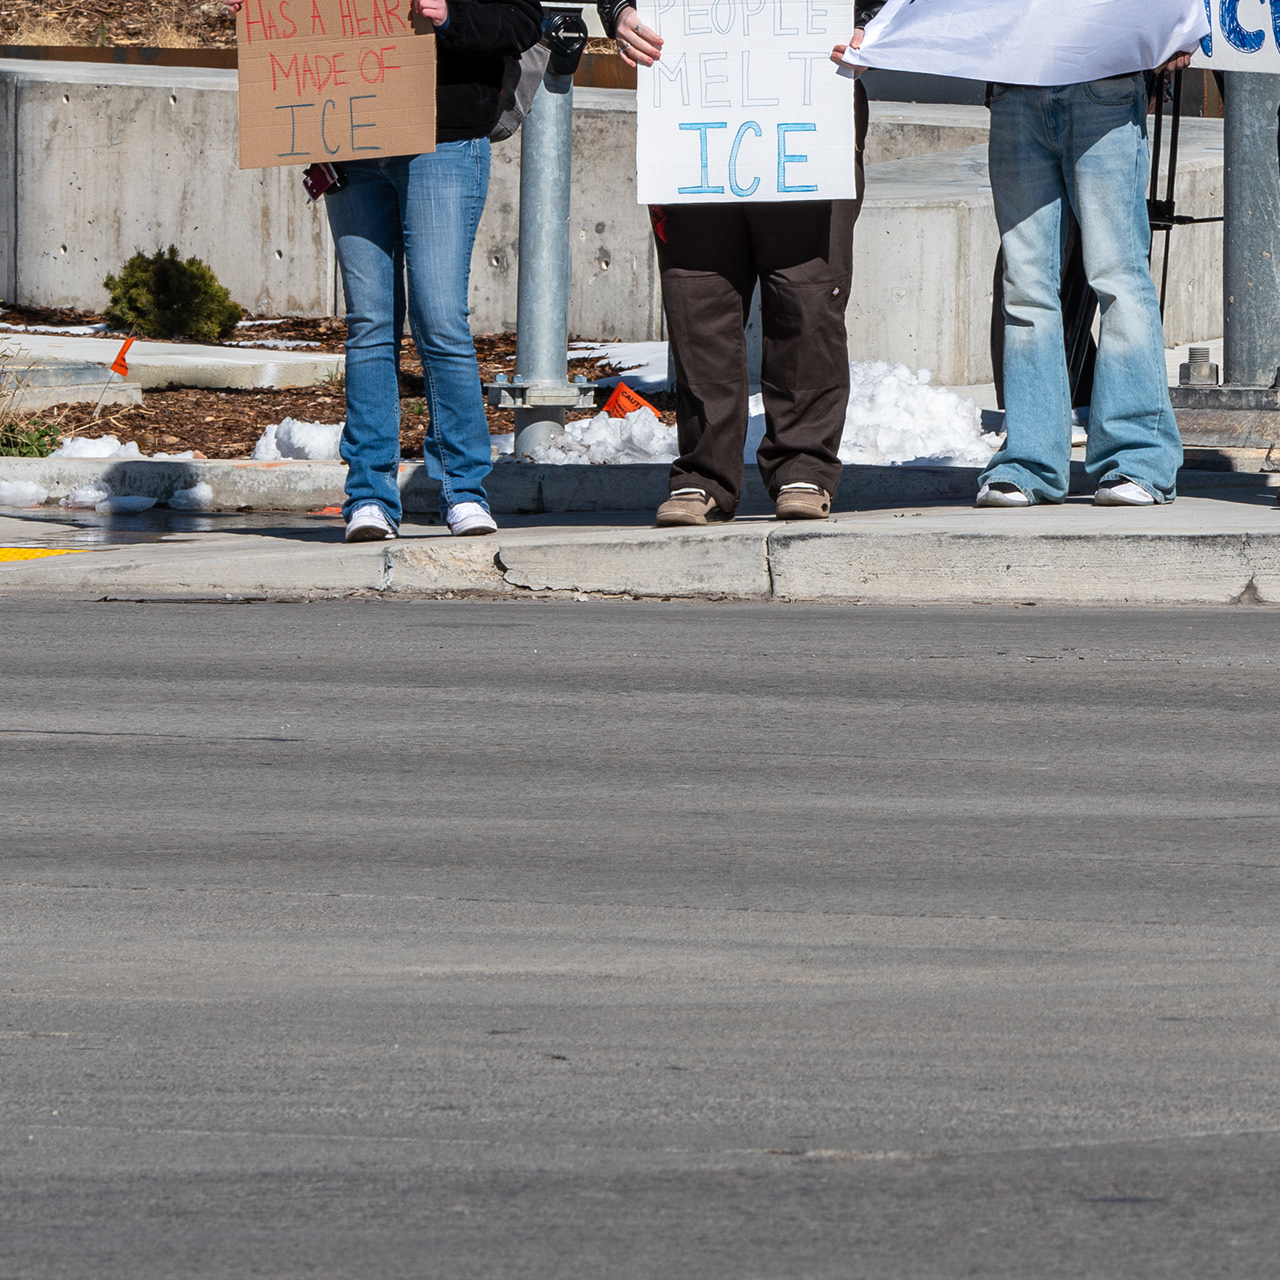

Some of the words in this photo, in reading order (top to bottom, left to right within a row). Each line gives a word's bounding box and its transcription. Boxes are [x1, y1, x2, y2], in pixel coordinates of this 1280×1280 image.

[269, 52, 350, 97] MADE
[359, 46, 401, 83] OF
[652, 50, 830, 108] MELT
[275, 94, 383, 157] ICE
[677, 120, 818, 198] ICE
[621, 390, 643, 409] CAUT
